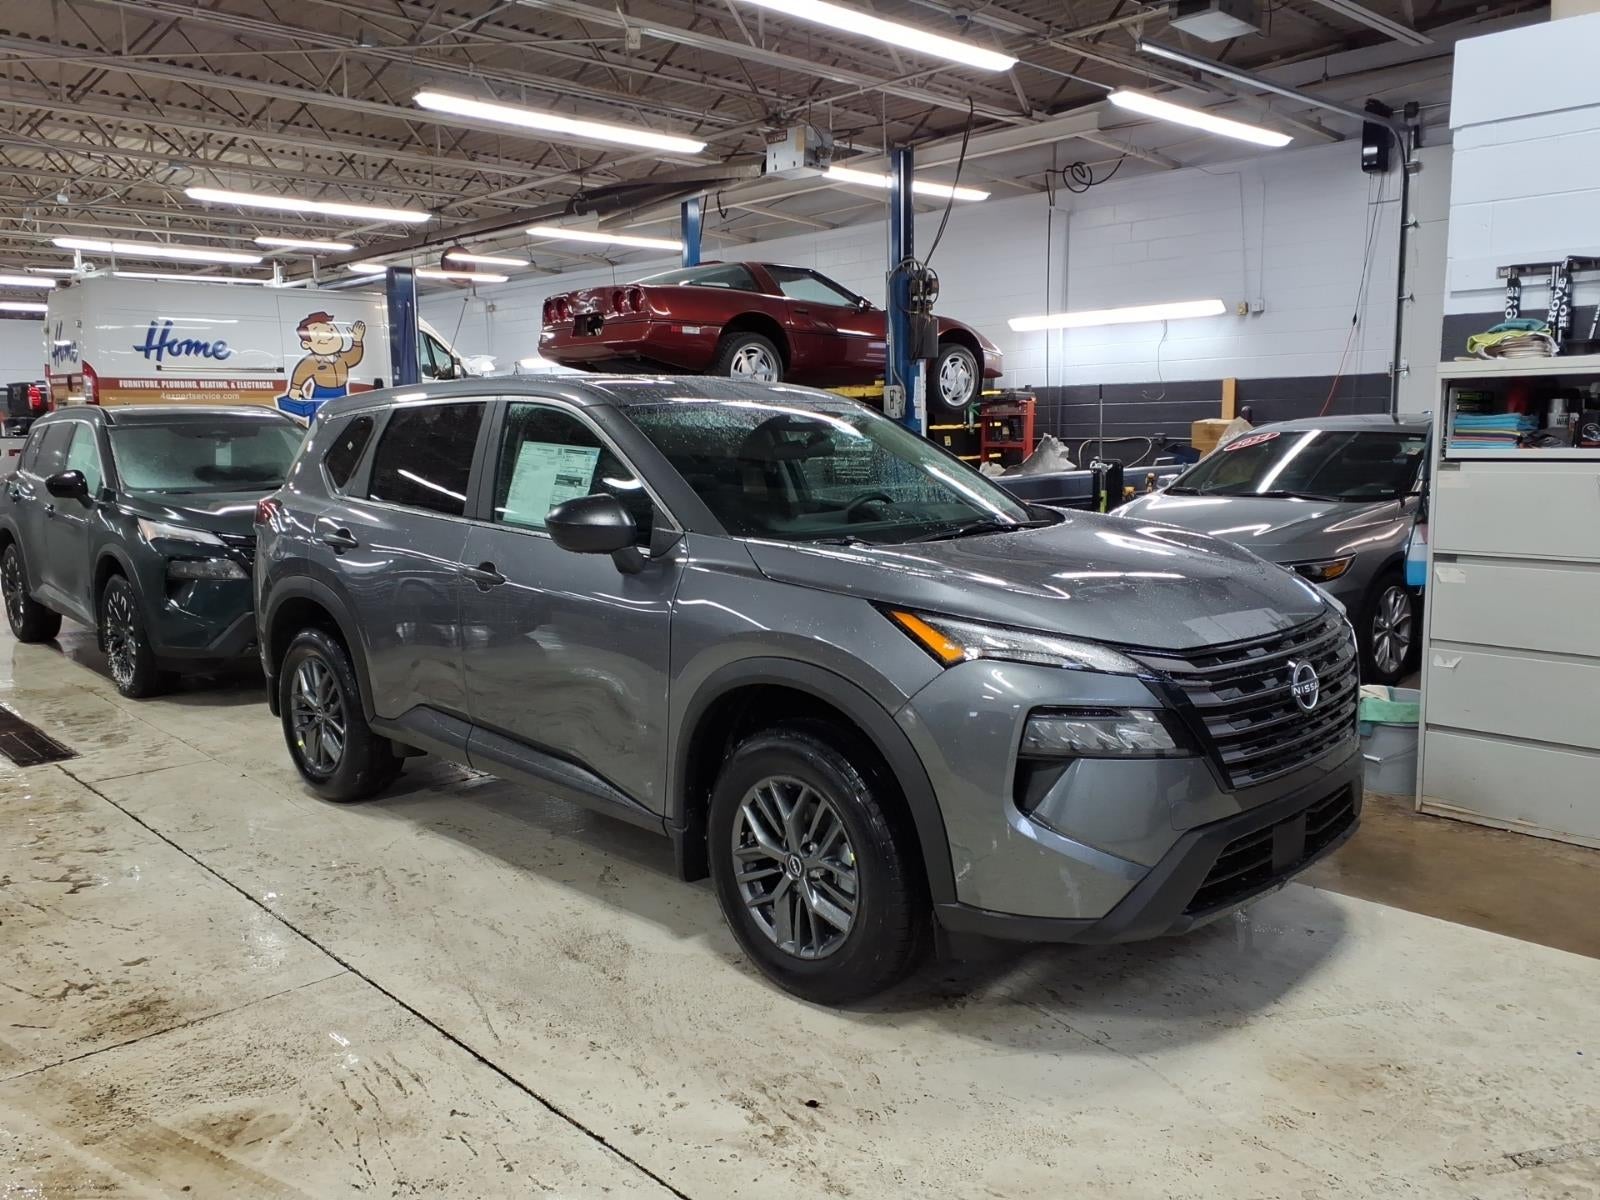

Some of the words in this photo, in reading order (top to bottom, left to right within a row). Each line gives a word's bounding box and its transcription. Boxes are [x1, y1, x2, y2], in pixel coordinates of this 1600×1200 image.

[1505, 287, 1513, 319] OVE
[133, 320, 232, 361] Home
[119, 379, 160, 389] FURNITURE,
[161, 380, 199, 389] PLUMBING,
[200, 380, 229, 389] HEATING,
[237, 381, 274, 389] ELECTRICAL
